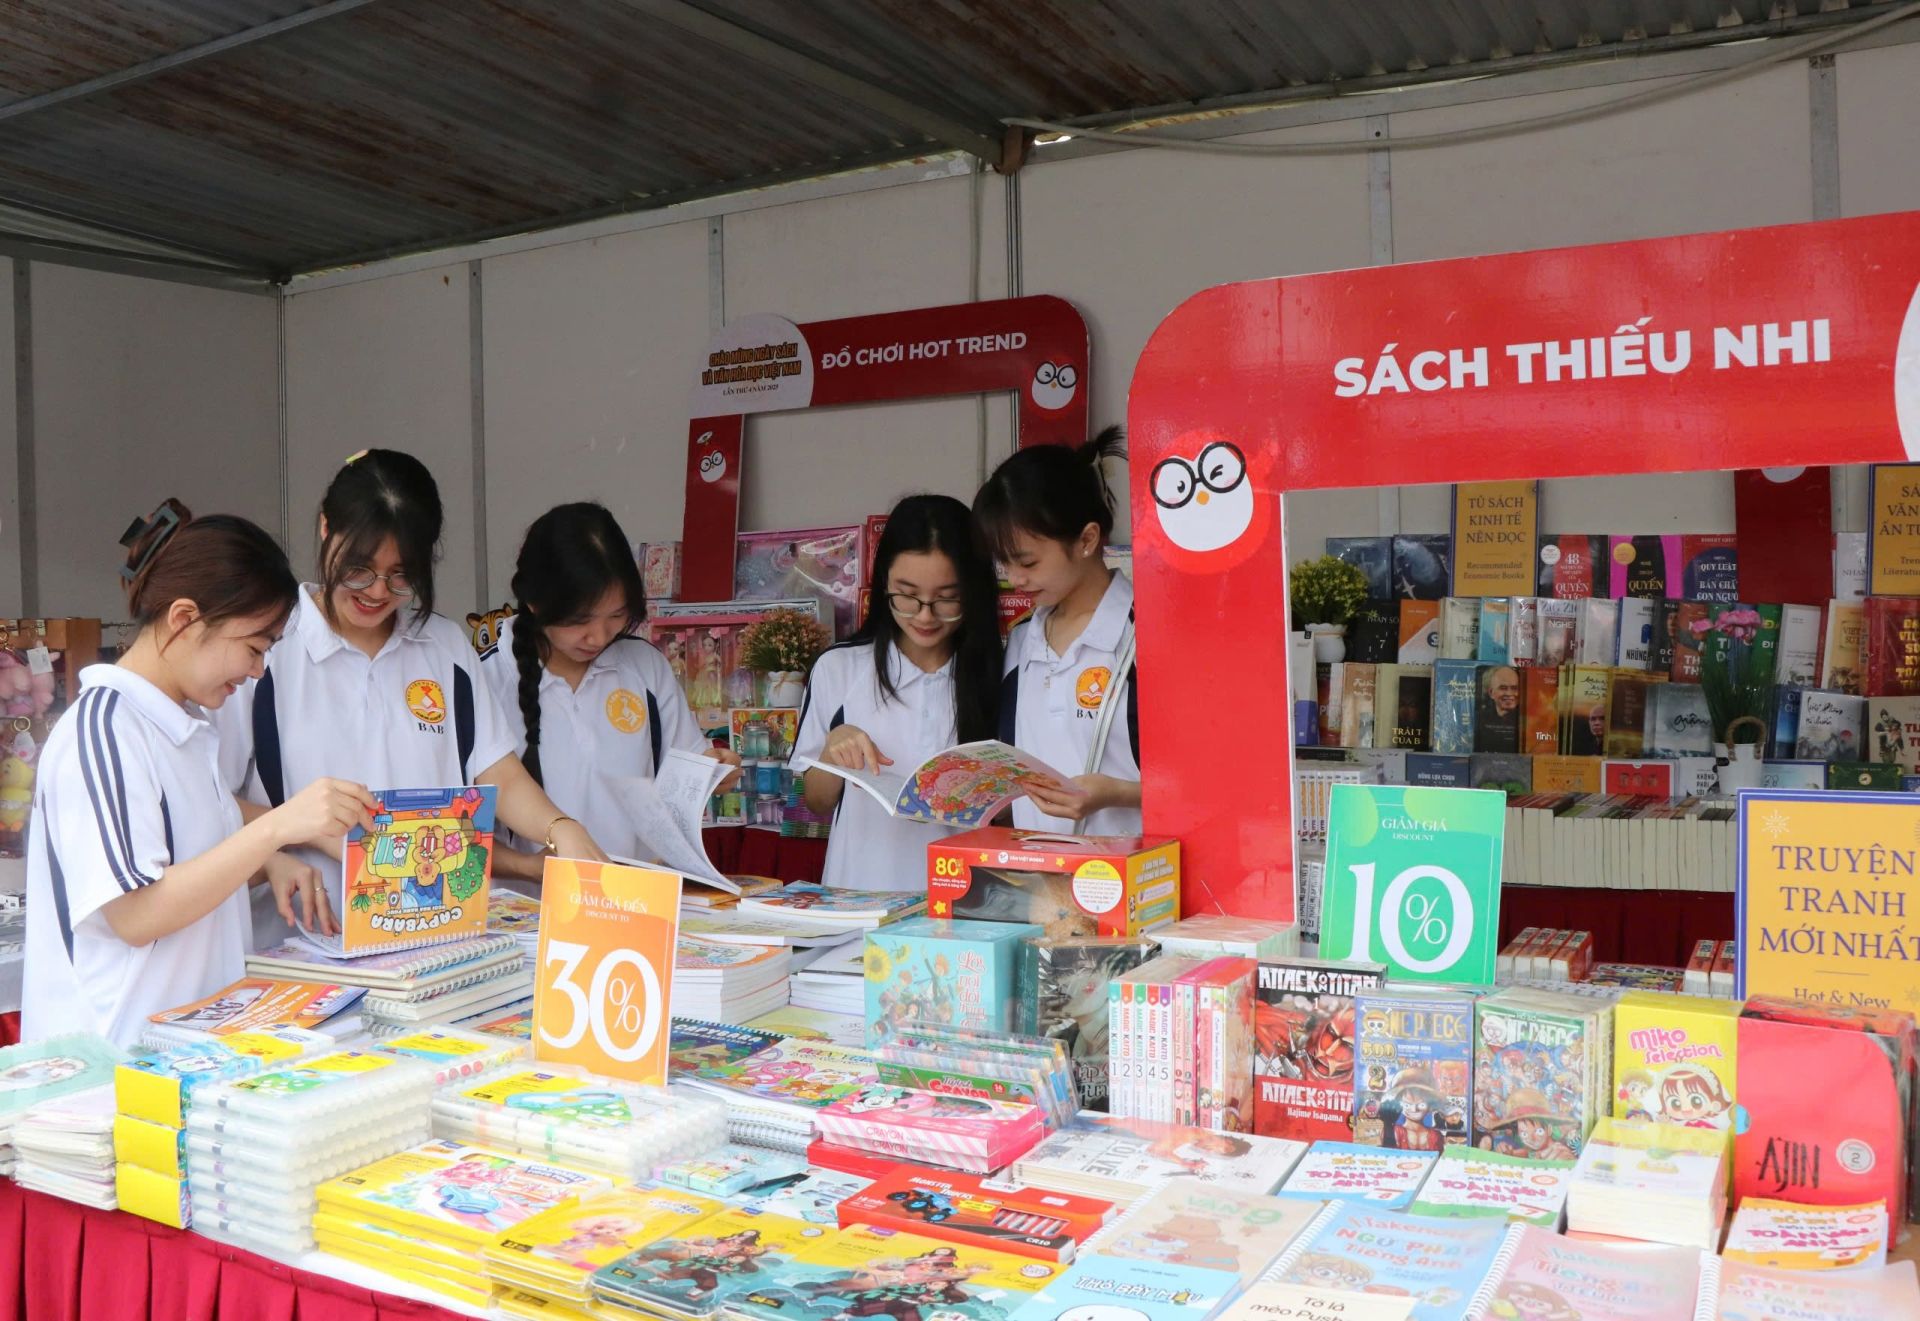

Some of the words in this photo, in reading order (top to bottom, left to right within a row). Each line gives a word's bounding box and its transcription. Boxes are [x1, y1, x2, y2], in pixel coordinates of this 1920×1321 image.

[821, 345, 851, 369] ĐỒ
[855, 342, 904, 366] CHƠI
[909, 340, 951, 360] HOT
[956, 332, 1027, 355] TREND
[1333, 343, 1489, 396] SÁCH
[1506, 316, 1691, 383] THIẾU
[1713, 319, 1830, 369] NHI
[1468, 495, 1485, 509] TỦ
[1488, 496, 1524, 508] SÁCH
[1469, 514, 1502, 526] KINH
[1506, 511, 1522, 525] TẾ
[1466, 530, 1494, 544] NÊN
[1565, 553, 1580, 565] 48
[1382, 816, 1419, 831] GIẢM
[1422, 817, 1448, 832] GIÁ
[1392, 832, 1435, 841] DISCOUNT
[936, 857, 959, 876] 80
[1772, 843, 1915, 881] TRUYỆN
[570, 892, 598, 907] GIẢM
[601, 894, 620, 910] GIÁ
[621, 896, 648, 913] ĐẾN
[1779, 886, 1906, 917] TRANH
[586, 911, 618, 921] DISCOUNT
[1342, 862, 1474, 974] 10%
[1759, 923, 1825, 955] MỚI
[1833, 924, 1920, 962] NHẤT
[1258, 967, 1316, 993] ATTACK
[1317, 972, 1328, 993] ON
[1328, 972, 1378, 996] TITAN
[539, 938, 662, 1062] 30%
[1794, 987, 1825, 1001] Hot
[1830, 990, 1844, 1004] &
[1850, 991, 1891, 1009] New
[1111, 1062, 1117, 1076] 1
[1123, 1063, 1131, 1078] 2
[1135, 1064, 1143, 1078] 3
[1148, 1065, 1156, 1079] 4
[1159, 1067, 1169, 1080] 5
[1262, 1082, 1316, 1108] ATTACK
[1317, 1090, 1327, 1108] ON
[1287, 1107, 1312, 1119] Hajime
[1313, 1111, 1344, 1123] Isayama
[866, 1126, 904, 1142] CRAYON
[872, 1140, 908, 1155] CRAYON
[1756, 1136, 1820, 1193] AJIN
[1850, 1152, 1861, 1164] 2
[1025, 1236, 1050, 1247] CR10
